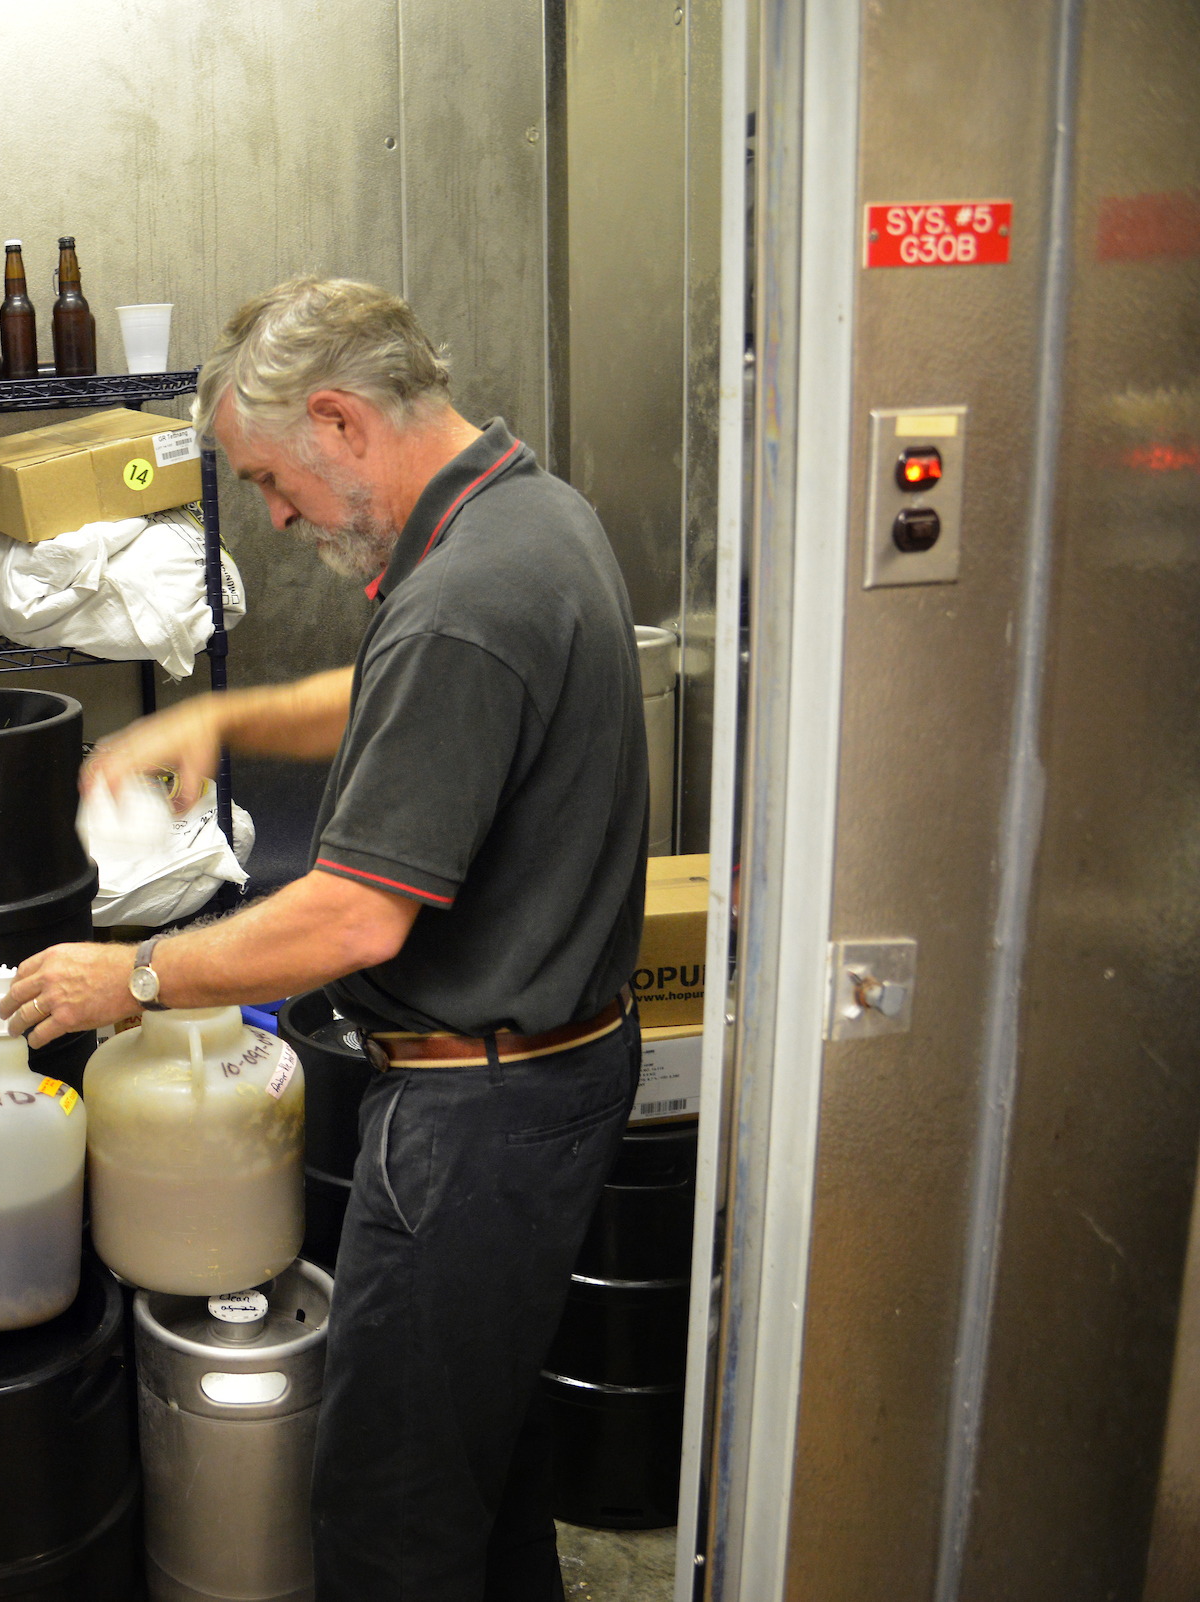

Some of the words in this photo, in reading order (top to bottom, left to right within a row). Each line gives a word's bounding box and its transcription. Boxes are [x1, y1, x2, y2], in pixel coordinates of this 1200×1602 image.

[955, 205, 993, 233] #5
[900, 233, 978, 263] G30B
[129, 464, 149, 485] 14
[631, 965, 705, 990] OPU
